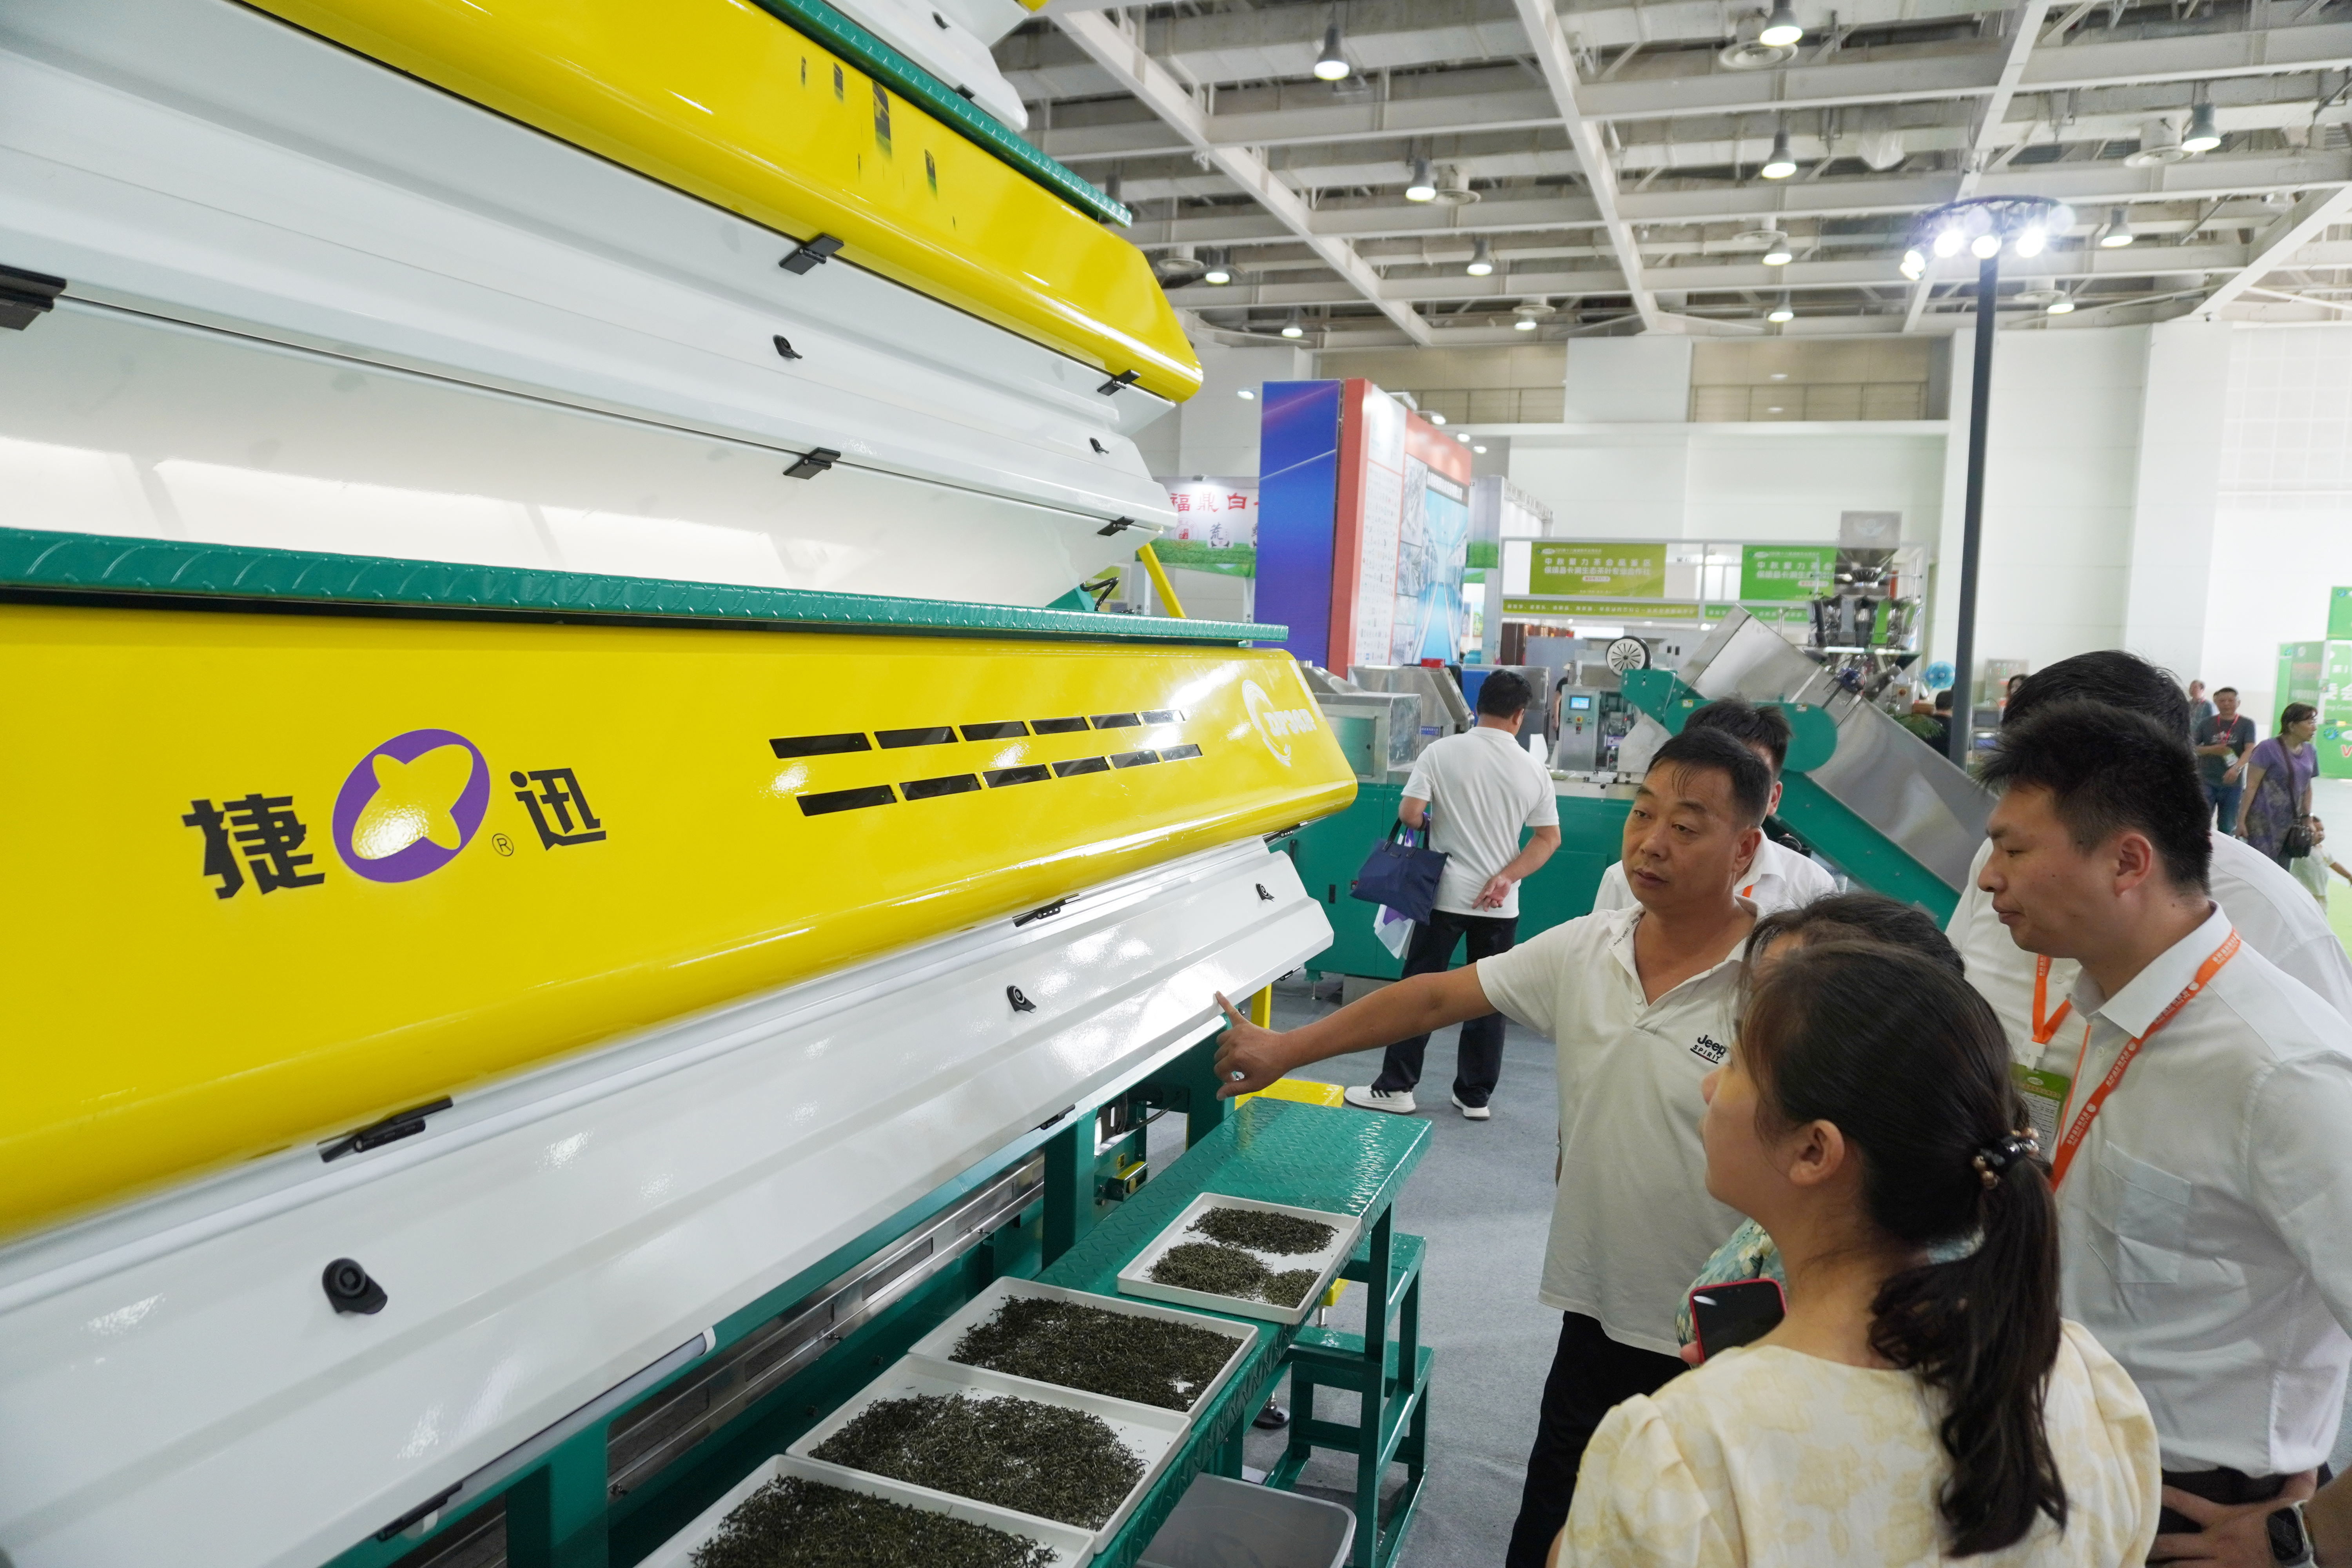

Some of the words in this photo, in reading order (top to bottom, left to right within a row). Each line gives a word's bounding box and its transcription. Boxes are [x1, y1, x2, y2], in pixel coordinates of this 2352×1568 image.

[1170, 491, 1259, 512] 福鼎白
[181, 793, 326, 900] 捷
[509, 767, 607, 851] 迅
[1693, 1044, 1720, 1062] SPIRIT
[1697, 1034, 1727, 1056] Jeep
